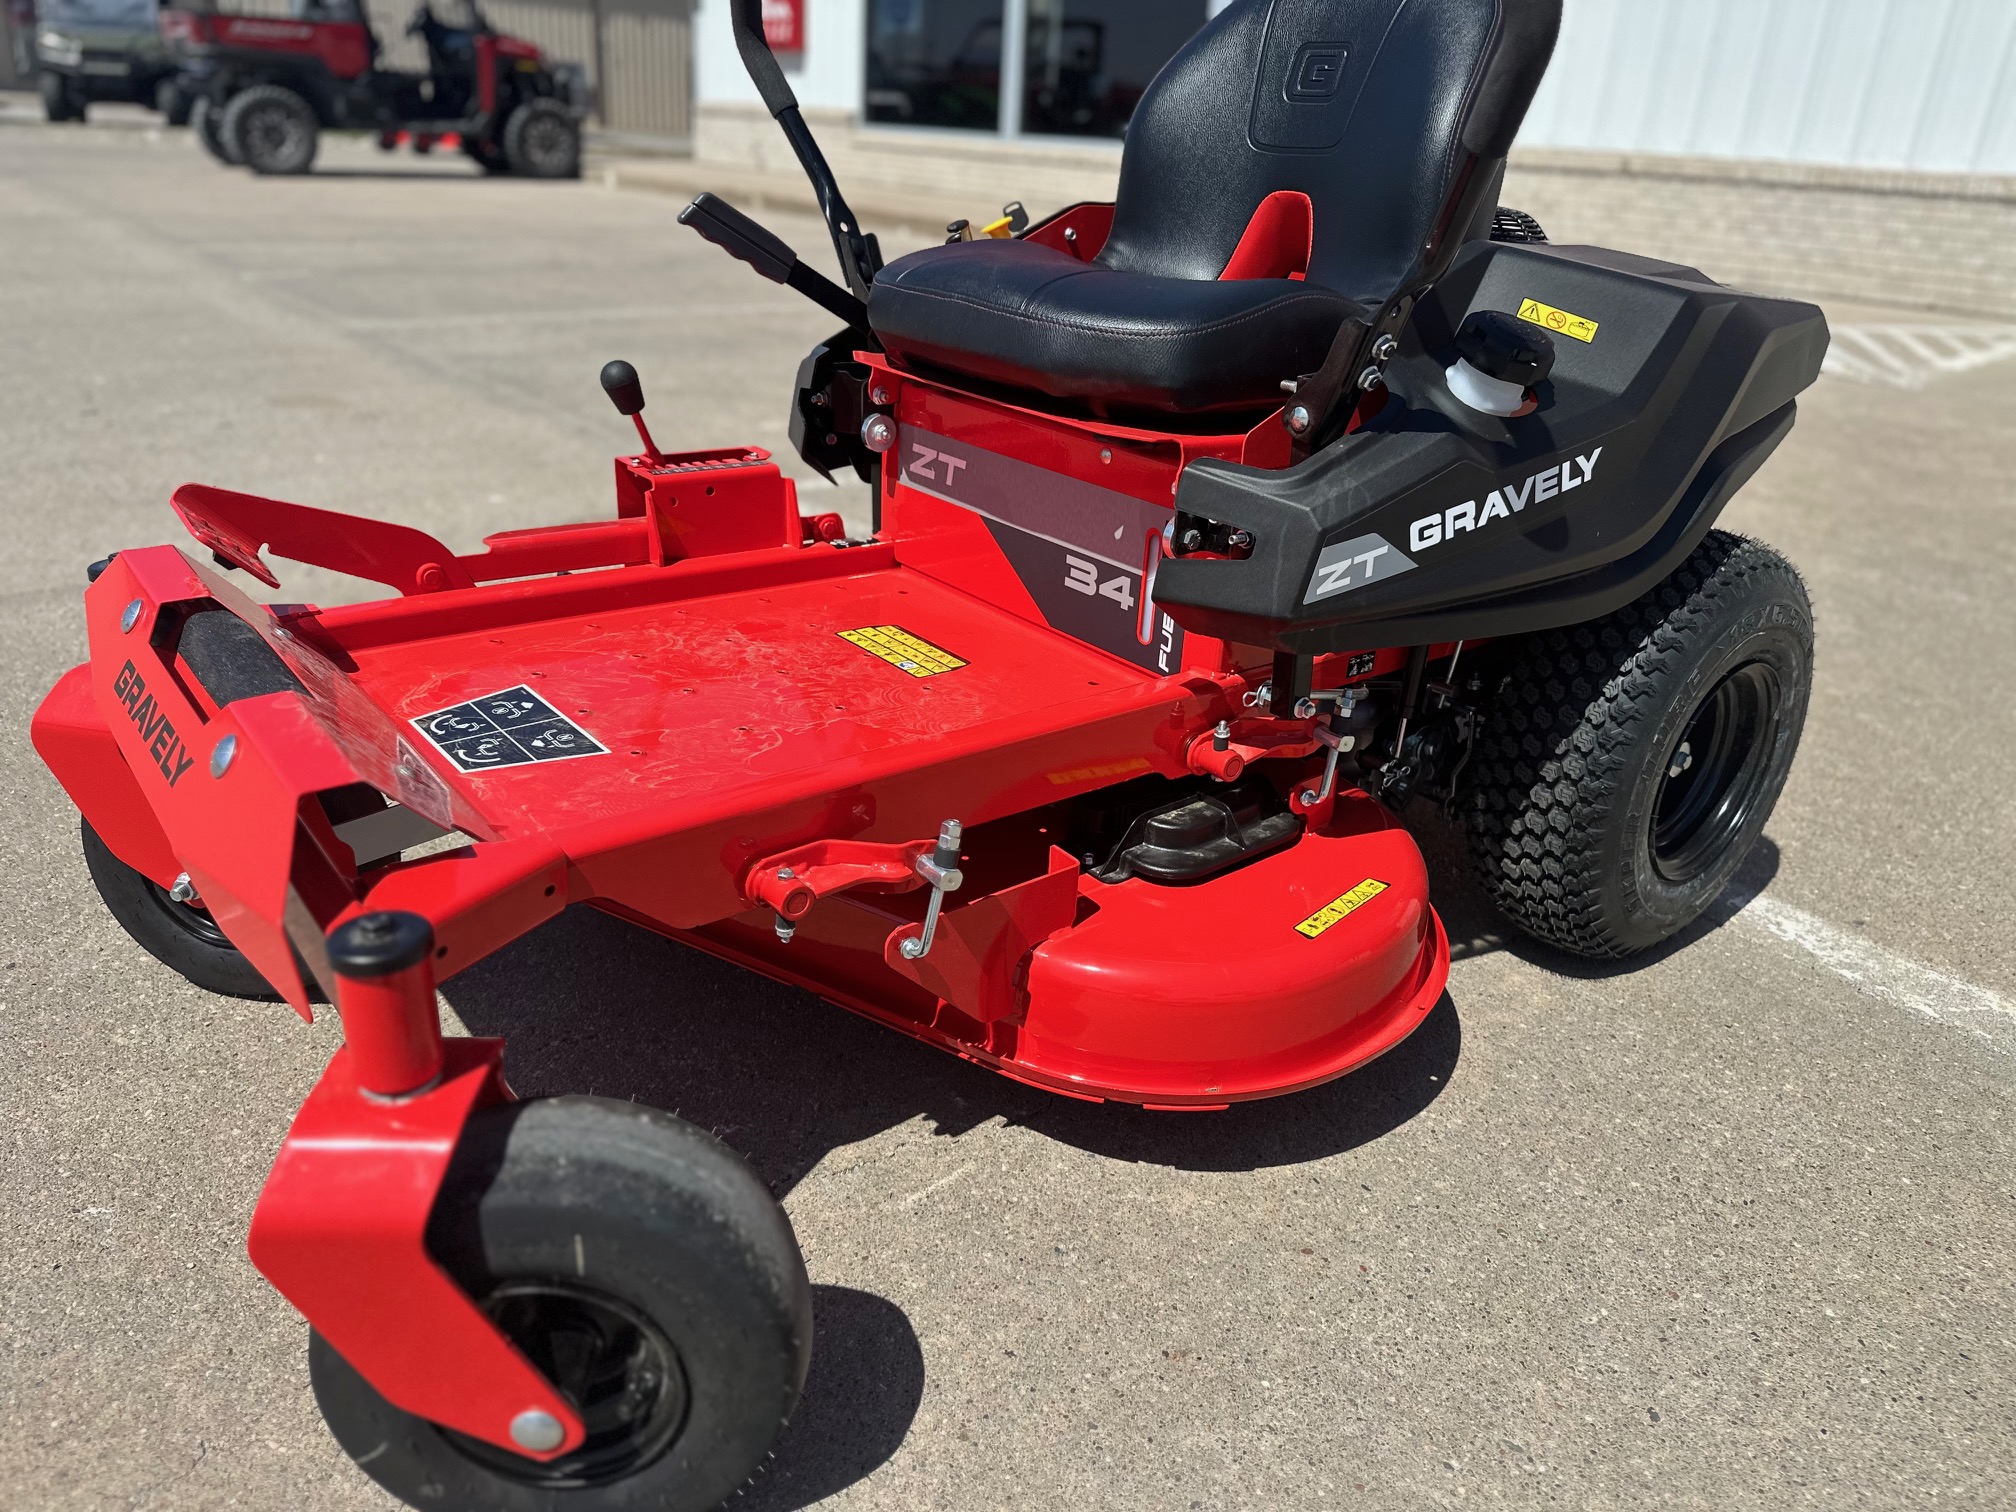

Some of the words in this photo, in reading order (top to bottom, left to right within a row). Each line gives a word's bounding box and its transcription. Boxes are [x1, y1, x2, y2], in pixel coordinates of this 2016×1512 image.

[1285, 45, 1350, 102] G
[910, 443, 967, 486] ZT
[1410, 446, 1603, 552] GRAVELY
[1064, 554, 1135, 611] 34
[1316, 545, 1389, 595] ZT
[1158, 612, 1175, 673] FUE
[113, 658, 195, 788] GRAVELY
